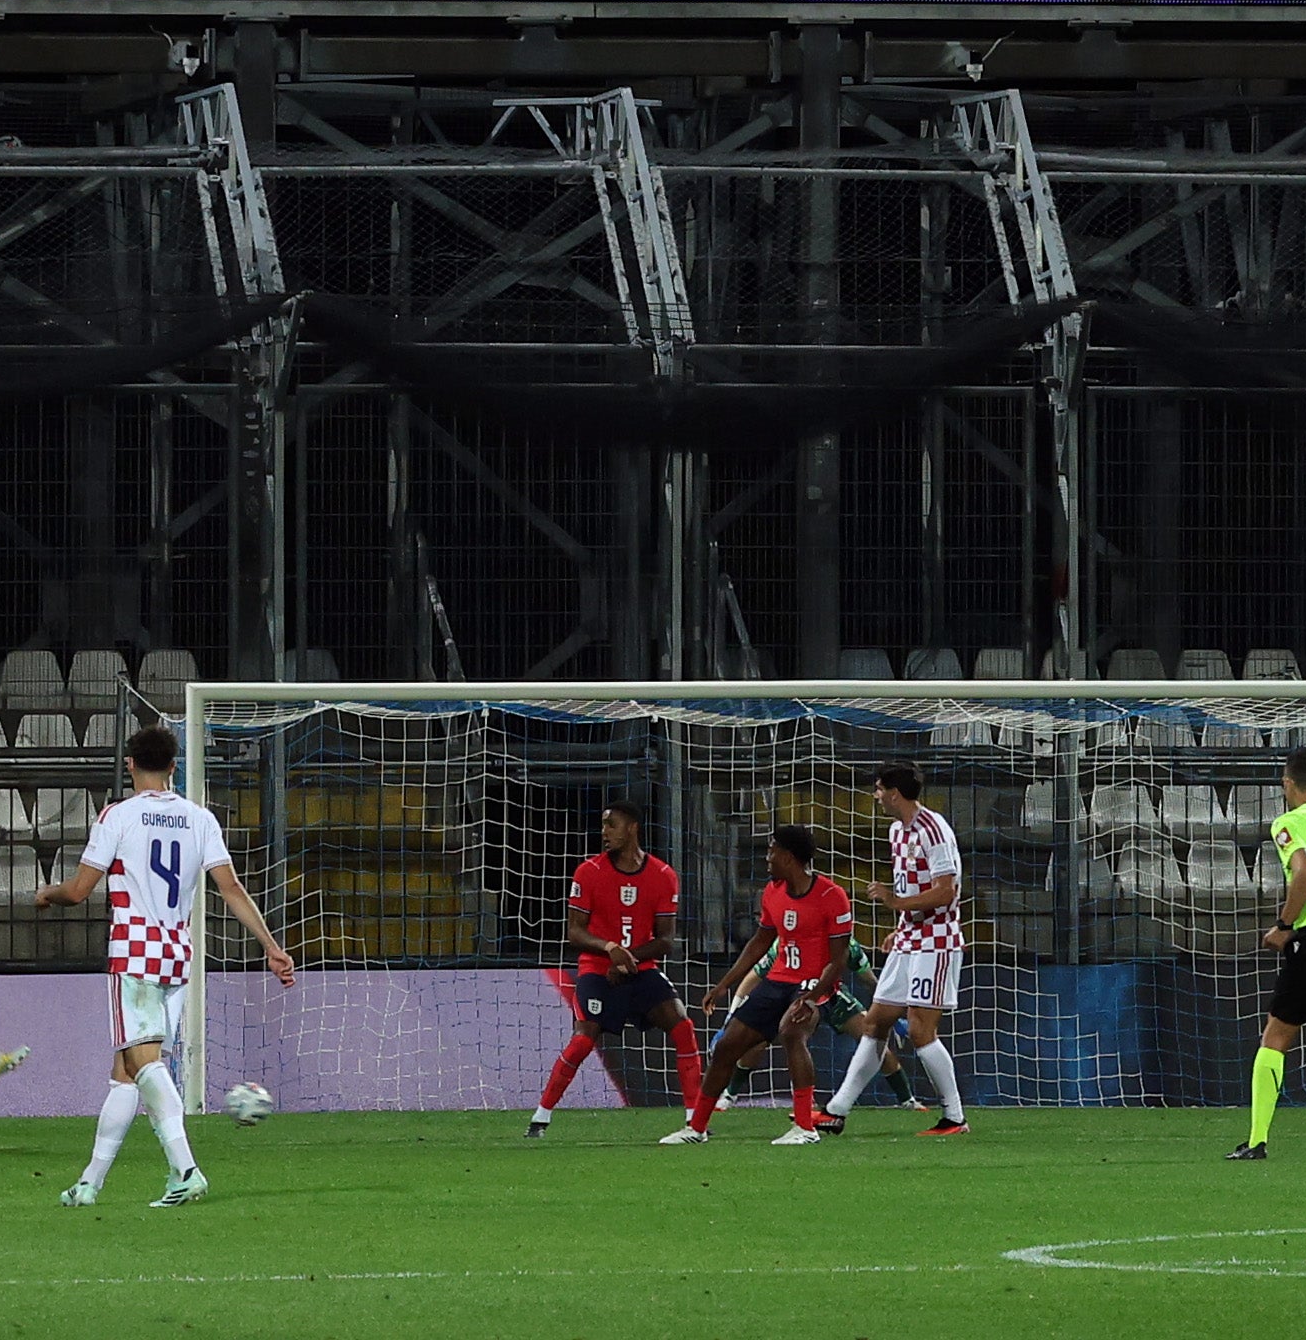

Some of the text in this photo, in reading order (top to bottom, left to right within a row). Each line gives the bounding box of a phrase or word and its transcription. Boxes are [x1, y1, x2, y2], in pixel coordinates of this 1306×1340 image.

[150, 839, 181, 909] 4
[621, 925, 633, 948] 5
[784, 946, 800, 970] 16
[911, 977, 933, 1000] 20
